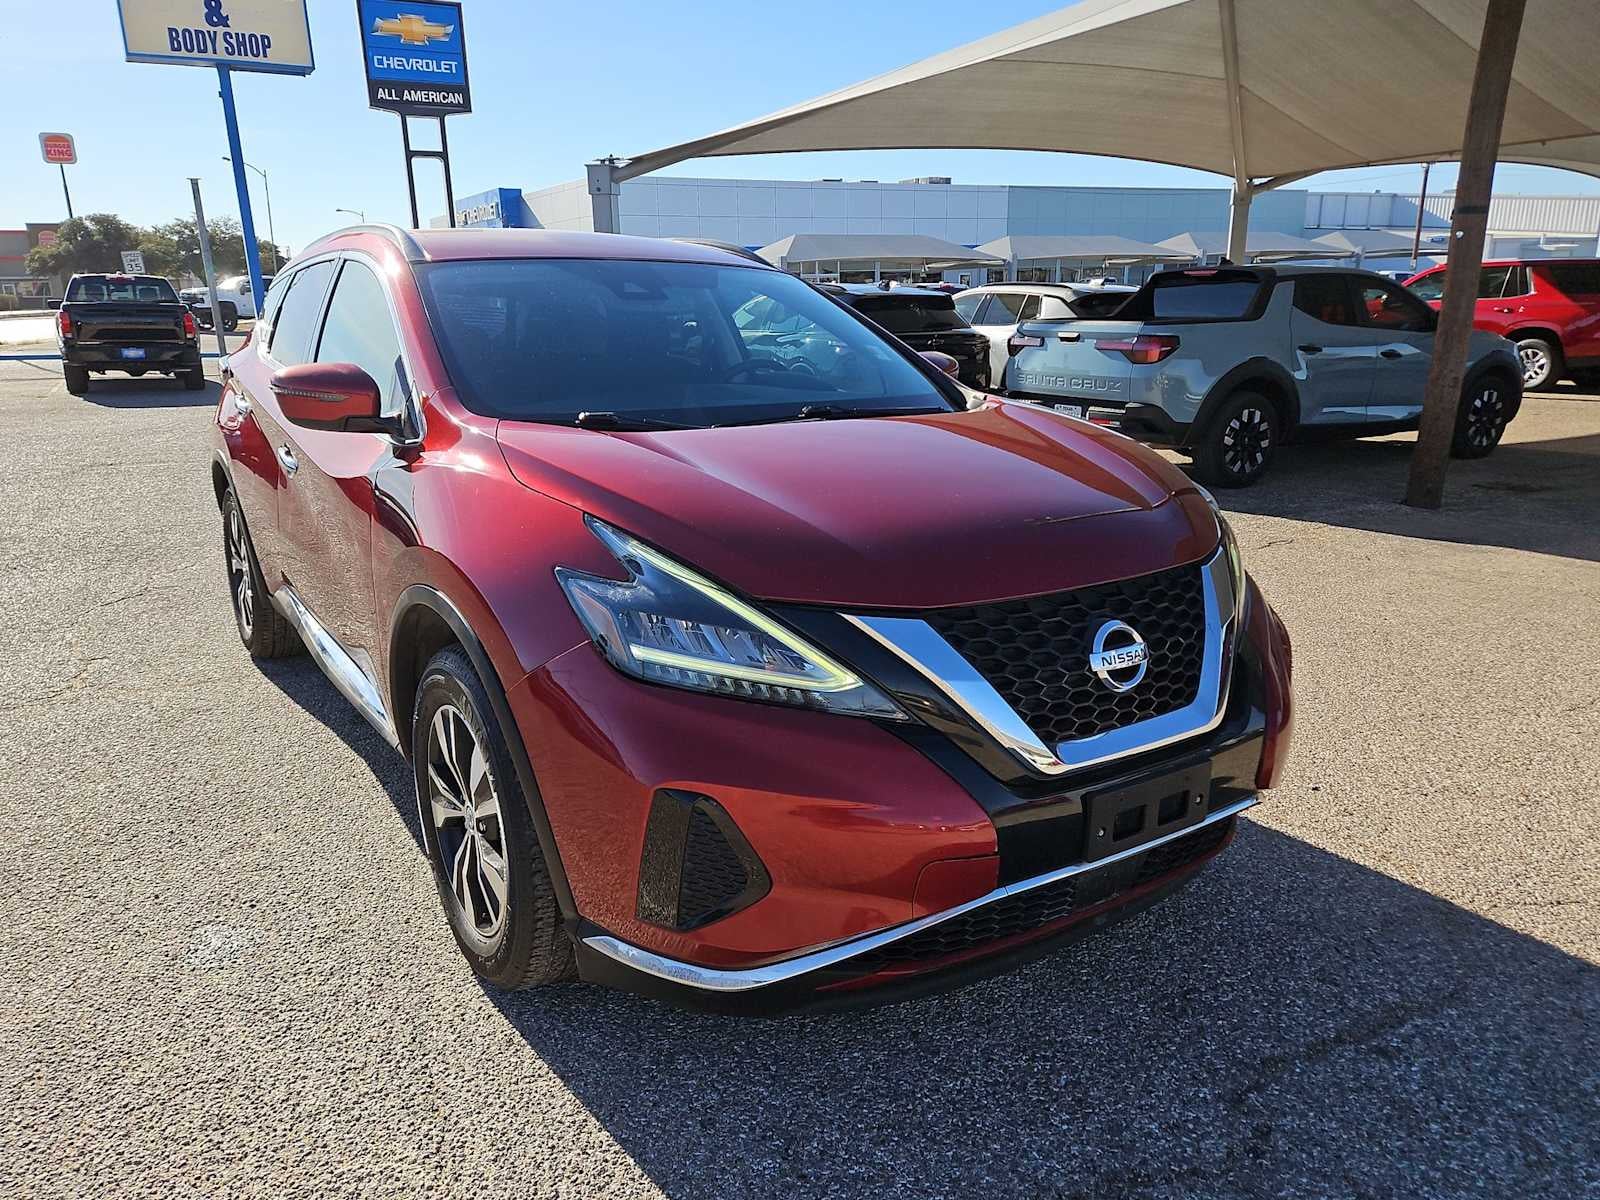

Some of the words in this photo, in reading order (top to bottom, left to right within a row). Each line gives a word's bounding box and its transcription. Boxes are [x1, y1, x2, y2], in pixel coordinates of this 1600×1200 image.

[204, 0, 230, 27] &
[168, 27, 217, 54] BODY
[222, 31, 272, 58] SHOP
[373, 55, 458, 74] CHEVROLET
[377, 87, 400, 101] ALL
[403, 89, 464, 105] AMERICAN
[45, 148, 73, 157] KING
[126, 263, 143, 272] 35
[1018, 374, 1067, 388] SANTA
[1071, 378, 1122, 392] CRUZ
[1101, 645, 1147, 667] NISSAN
